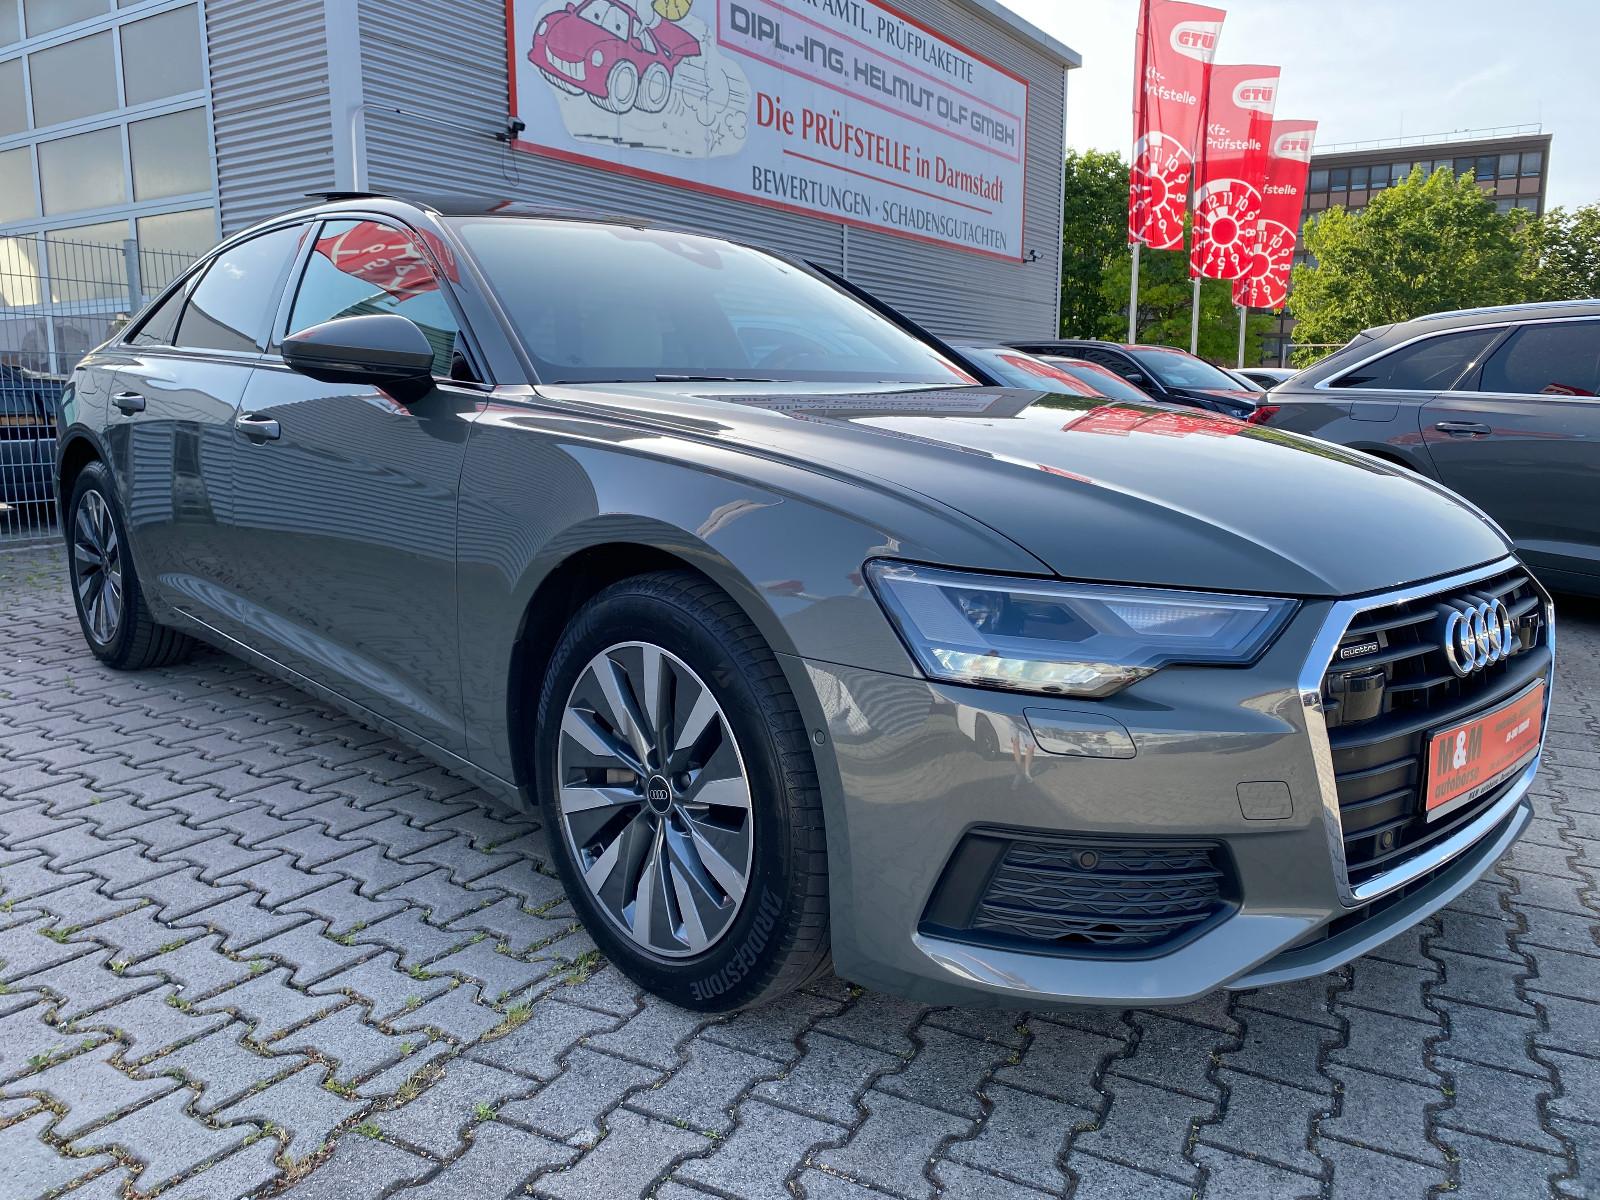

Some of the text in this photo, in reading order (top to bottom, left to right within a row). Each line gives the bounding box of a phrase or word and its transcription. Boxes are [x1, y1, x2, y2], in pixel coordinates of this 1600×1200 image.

[877, 16, 974, 84] PRÜFPLAKETTE
[854, 57, 934, 112] HELMUT
[937, 95, 968, 126] OLF
[756, 91, 1004, 204] Die PRÜFSTELLE in Darmstadt
[1207, 123, 1230, 136] Kfz-
[1207, 136, 1262, 151] Prüfstelle
[752, 165, 1007, 251] BEWERTUNGEN SCHADENSGUTACHTEN
[1343, 643, 1378, 657] quattro
[1437, 723, 1484, 778] M&M
[689, 884, 784, 1001] BRIDGESTONE
